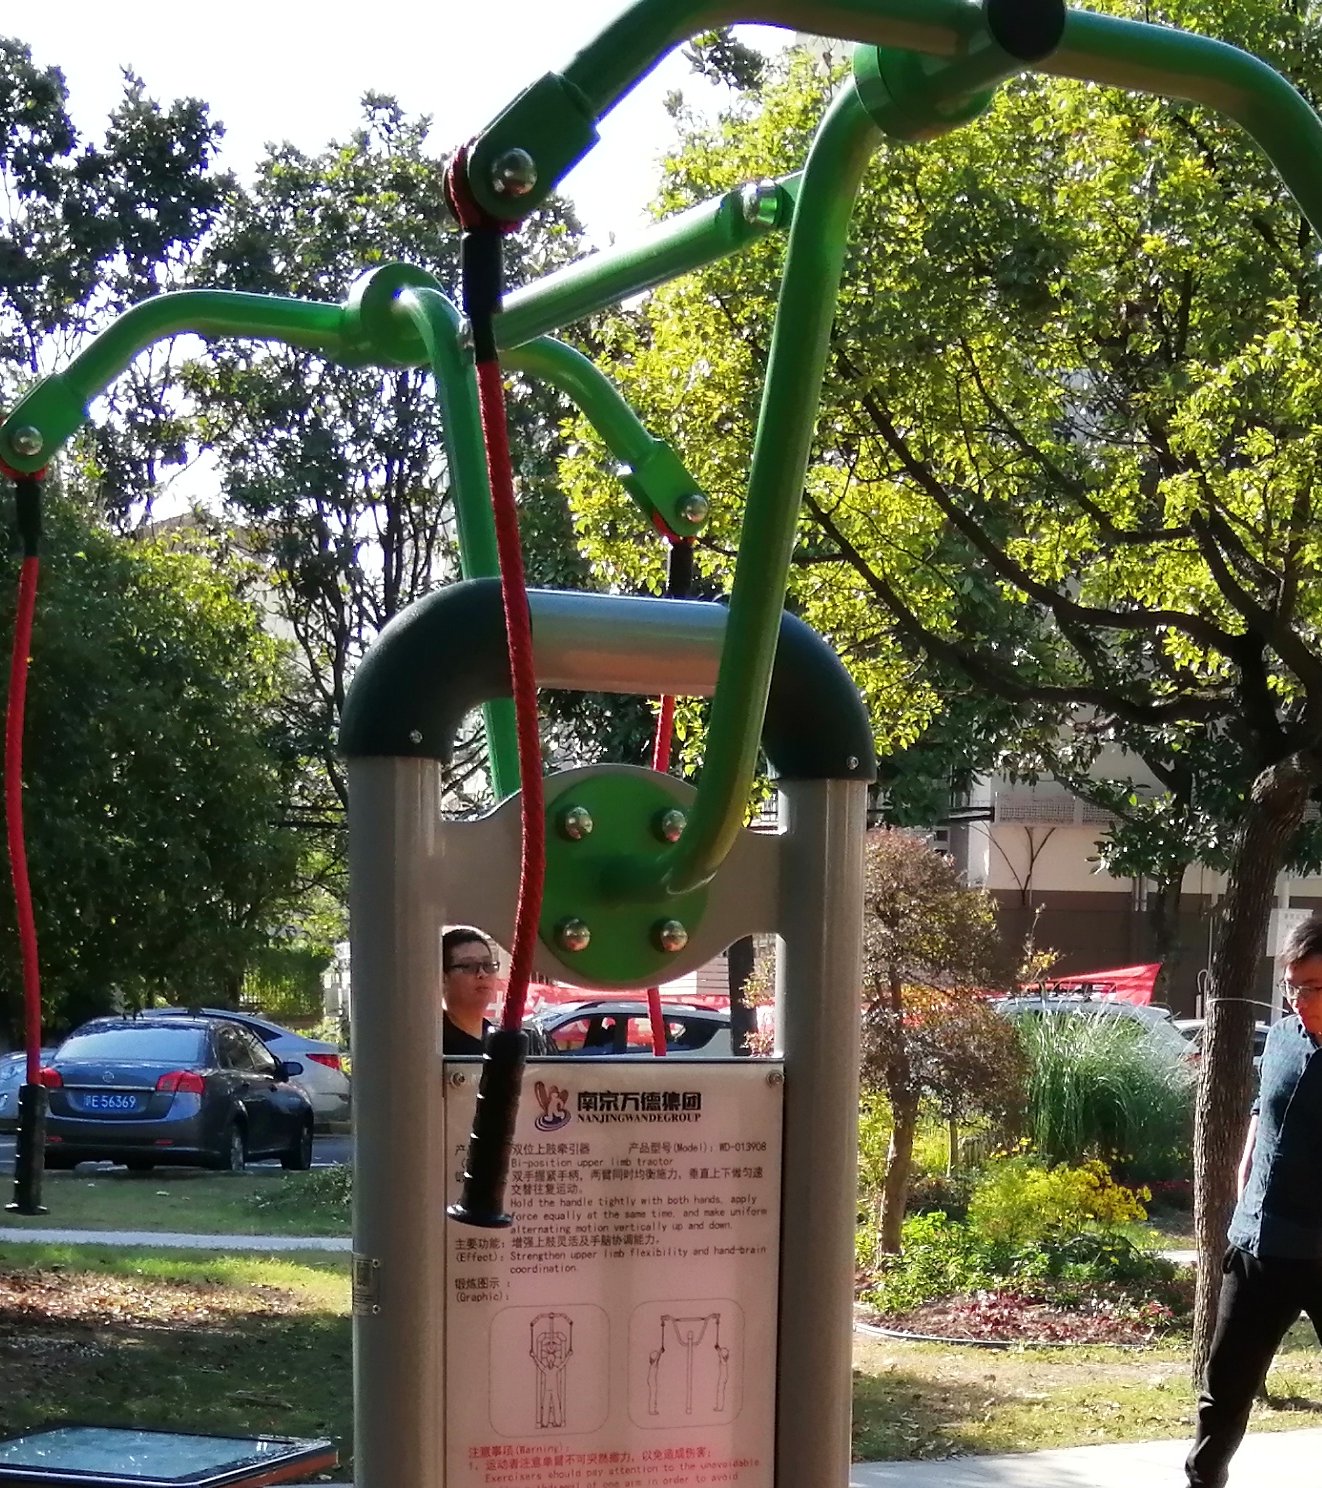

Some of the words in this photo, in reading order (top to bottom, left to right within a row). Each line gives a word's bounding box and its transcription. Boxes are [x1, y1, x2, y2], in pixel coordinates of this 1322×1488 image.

[101, 1096, 136, 1108] 56369
[578, 1090, 702, 1112] 南京万德集团
[577, 1113, 702, 1124] NANJINGWANDEGROUP
[512, 1143, 590, 1155] 双位上肢牵引器
[719, 1141, 767, 1154] WD-013908
[511, 1158, 573, 1168] Bi-position
[577, 1160, 603, 1168] upper
[611, 1157, 632, 1166] limb
[637, 1157, 673, 1166] tractor
[511, 1184, 583, 1196] 交替往复运动。
[511, 1198, 533, 1208] Hold
[539, 1198, 555, 1208] the
[561, 1198, 593, 1207] handle
[599, 1197, 636, 1208] tightly
[641, 1196, 663, 1206] with
[667, 1195, 689, 1205] both
[731, 1194, 757, 1205] apply
[511, 1211, 537, 1221] force
[543, 1210, 581, 1222] equally
[587, 1211, 597, 1220] at
[603, 1210, 619, 1219] the
[625, 1210, 646, 1219] same
[683, 1208, 699, 1218] and
[704, 1208, 725, 1217] make
[730, 1206, 767, 1217] uniform
[511, 1224, 570, 1236] alternating
[576, 1224, 609, 1233] motion
[614, 1222, 667, 1233] vertically
[673, 1223, 683, 1232] up
[688, 1222, 705, 1230] and
[511, 1250, 566, 1262] Strengthen
[571, 1251, 597, 1262] upper
[605, 1248, 625, 1258] limb
[631, 1248, 688, 1259] flexibility
[693, 1246, 709, 1256] and
[485, 1472, 542, 1484] Exercisers
[548, 1469, 581, 1480] should
[587, 1470, 603, 1480] pay
[609, 1464, 658, 1476] attention
[663, 1464, 674, 1472] to
[680, 1462, 695, 1471] the
[701, 1458, 760, 1470] unavoidable
[603, 1480, 619, 1488] one
[648, 1478, 657, 1486] in
[663, 1475, 689, 1486] order
[696, 1475, 706, 1484] to
[711, 1472, 739, 1482] avoid
